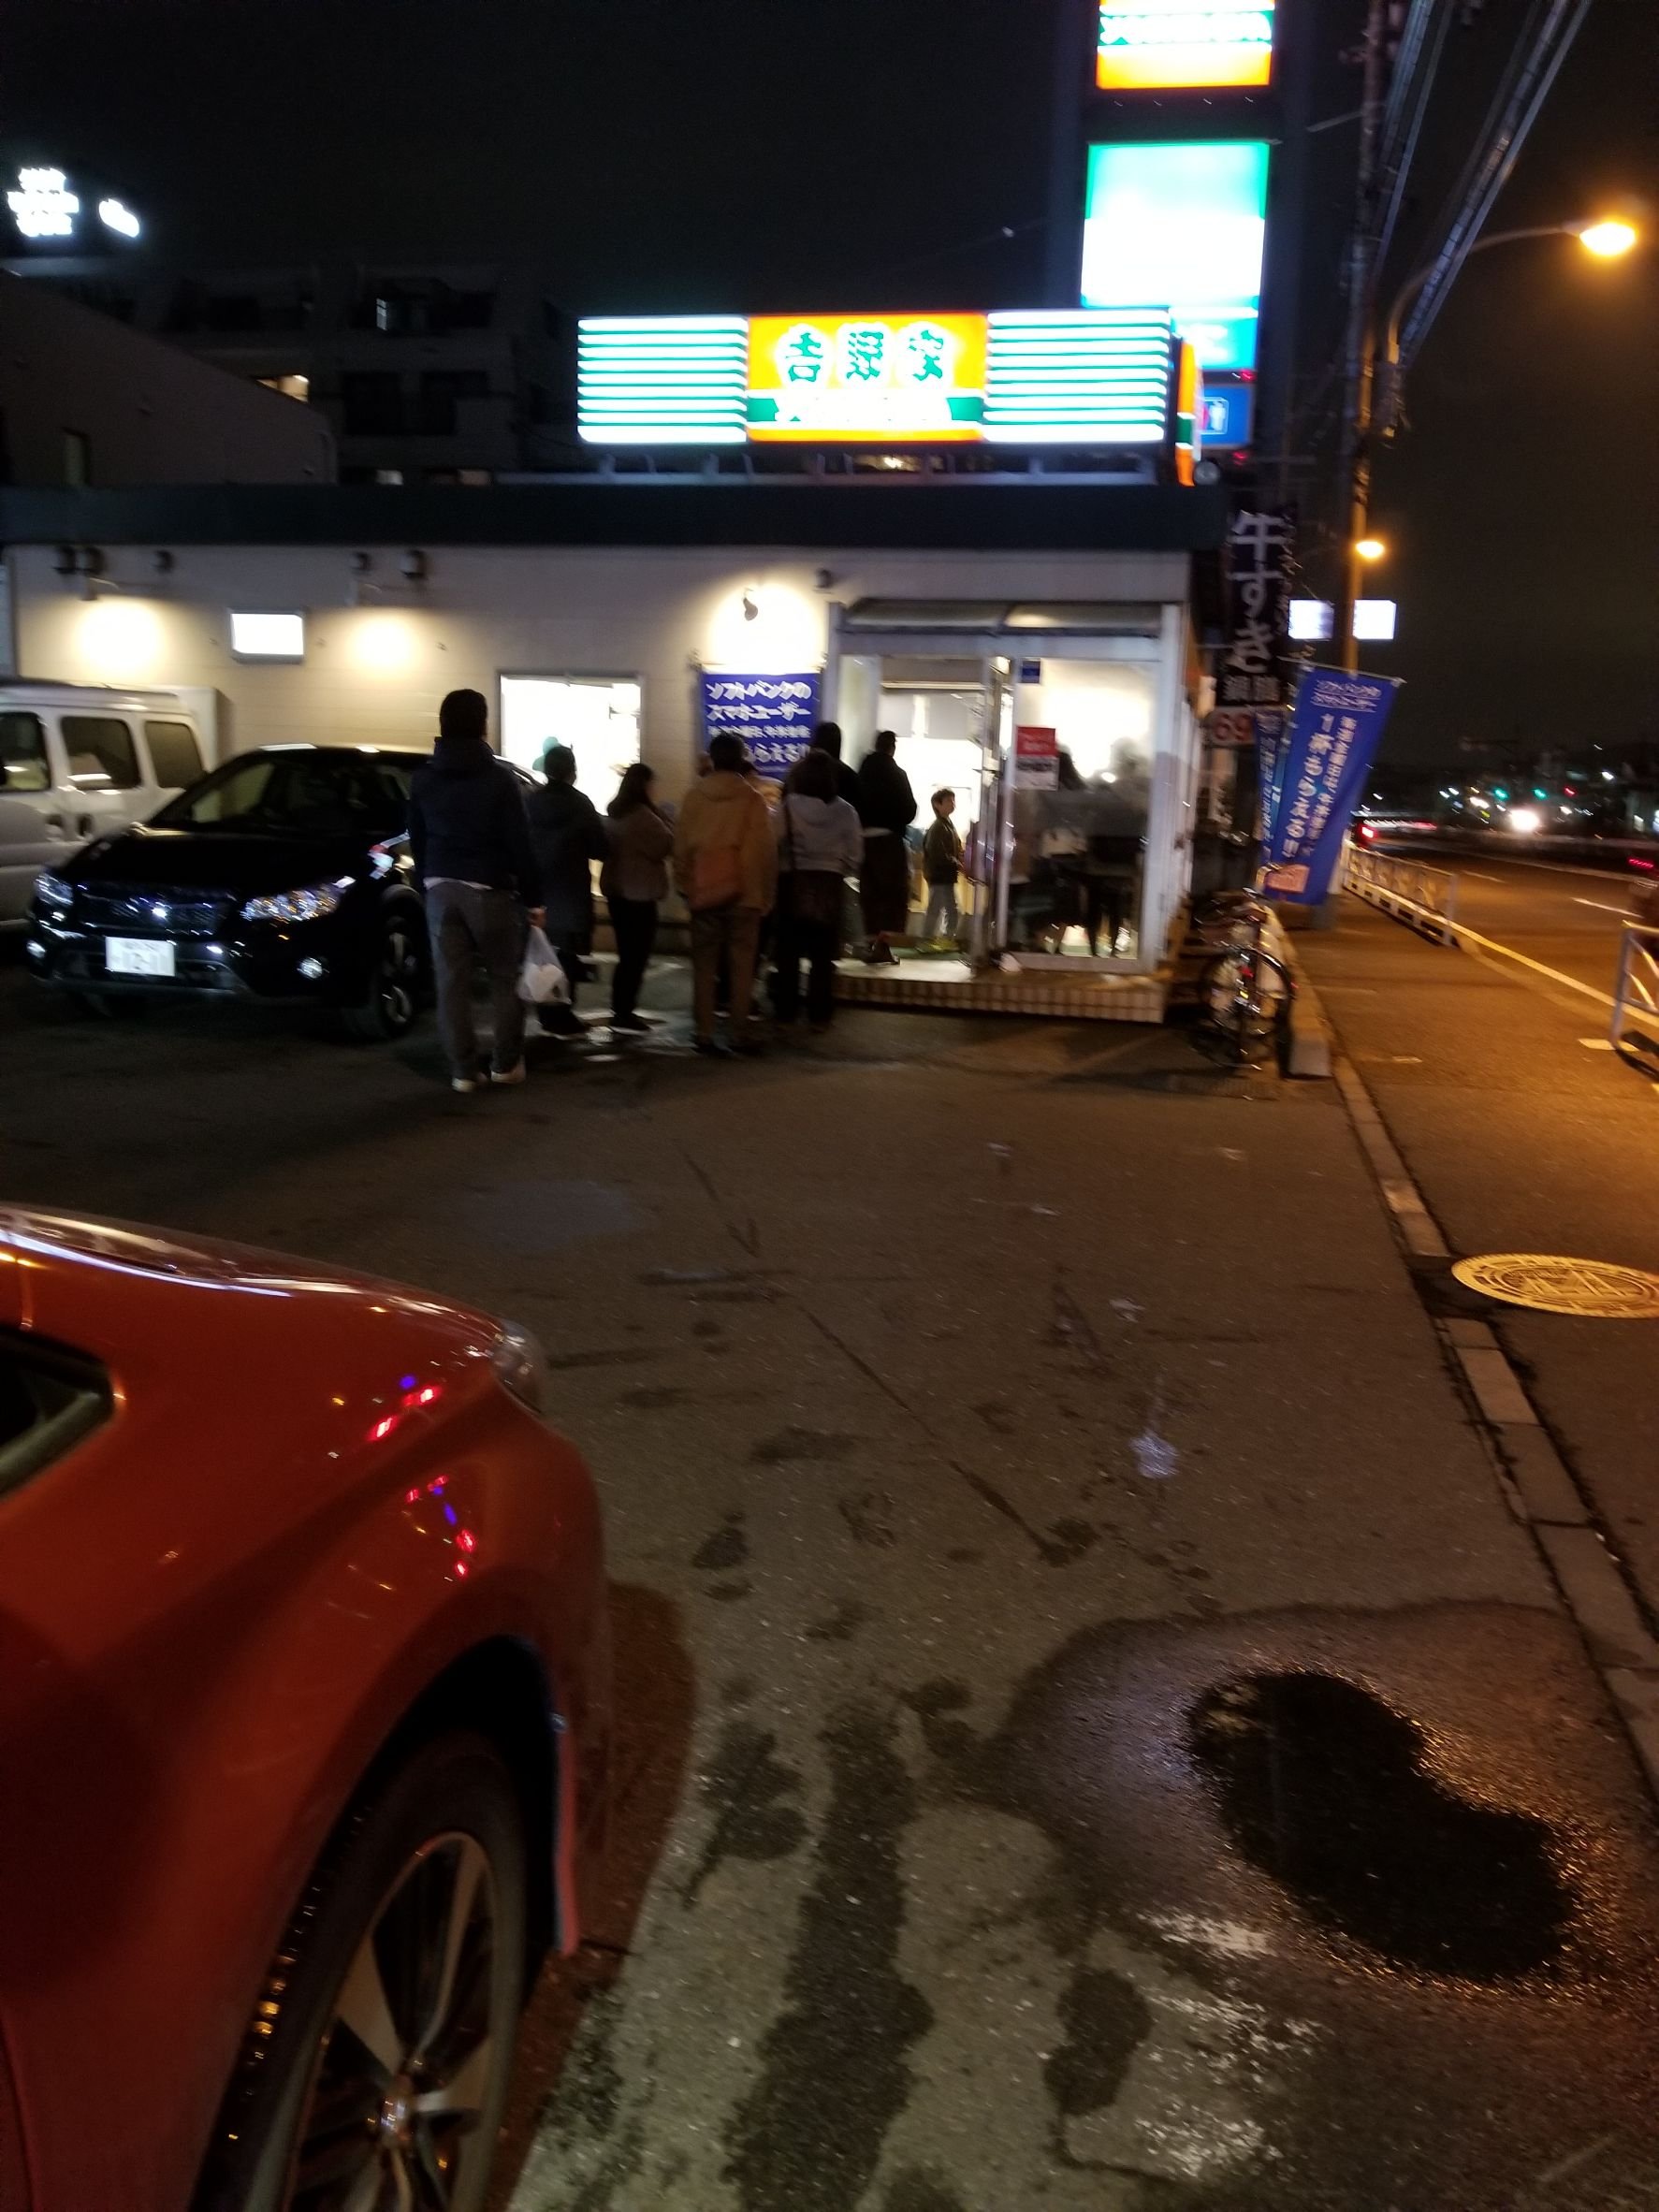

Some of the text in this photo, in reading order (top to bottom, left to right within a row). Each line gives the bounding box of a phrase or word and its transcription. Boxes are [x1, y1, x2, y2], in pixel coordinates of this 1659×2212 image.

[706, 680, 812, 701] ソフトバンクの
[706, 701, 812, 722] スマホユーザー
